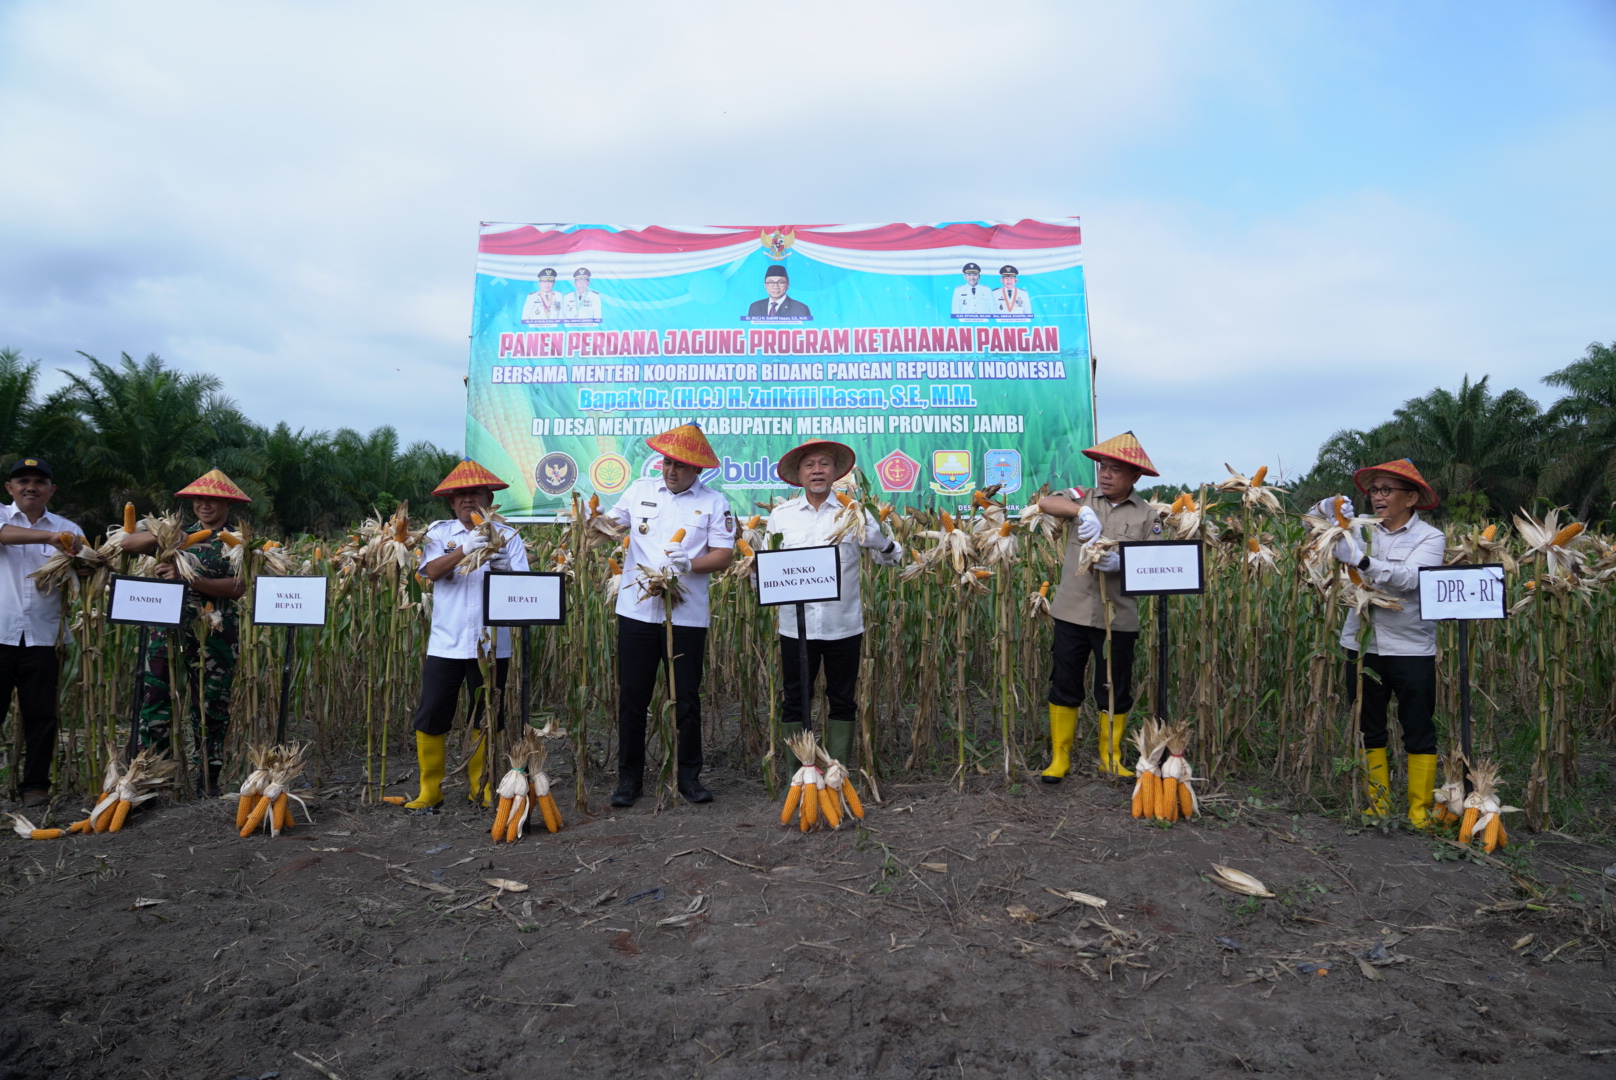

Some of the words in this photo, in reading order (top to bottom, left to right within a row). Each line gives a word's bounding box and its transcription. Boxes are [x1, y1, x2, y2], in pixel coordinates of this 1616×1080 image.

[500, 332, 564, 358] PANEN
[567, 331, 660, 358] PERDANA
[662, 330, 746, 356] JAGUNG
[749, 328, 850, 355] PROGRAM
[853, 327, 973, 355] KETAHANAN
[976, 326, 1059, 353] PANGAN
[492, 366, 568, 384] BERSAMA
[571, 364, 640, 382] MENTERI
[643, 364, 758, 382] KOORDINATOR
[761, 363, 824, 381] BIDANG
[827, 362, 892, 380] PANGAN
[896, 362, 975, 380] REPUBLIK
[978, 361, 1066, 379] INDONESIA
[578, 388, 642, 412] Bapak
[643, 387, 670, 410] Dr.
[672, 386, 725, 410] (H.C.)
[727, 386, 747, 410] H.
[748, 386, 818, 410] Zulkifli
[820, 385, 888, 411] Hasan,
[890, 385, 928, 410] S.E.,
[930, 384, 977, 408] M.M.
[532, 418, 550, 436] DI
[553, 418, 595, 436] DESA
[699, 416, 792, 435] KABUPATEN
[797, 416, 884, 435] MERANGIN
[889, 415, 969, 434] PROVINSI
[972, 414, 1024, 434] JAMBI
[782, 566, 816, 576] MENKO
[1136, 566, 1184, 574] GUBERNUR
[764, 578, 798, 588] BIDANG
[800, 576, 836, 586] PANGAN
[1437, 580, 1466, 602] DPR
[1479, 579, 1494, 602] RI
[130, 595, 162, 604] DANDIM
